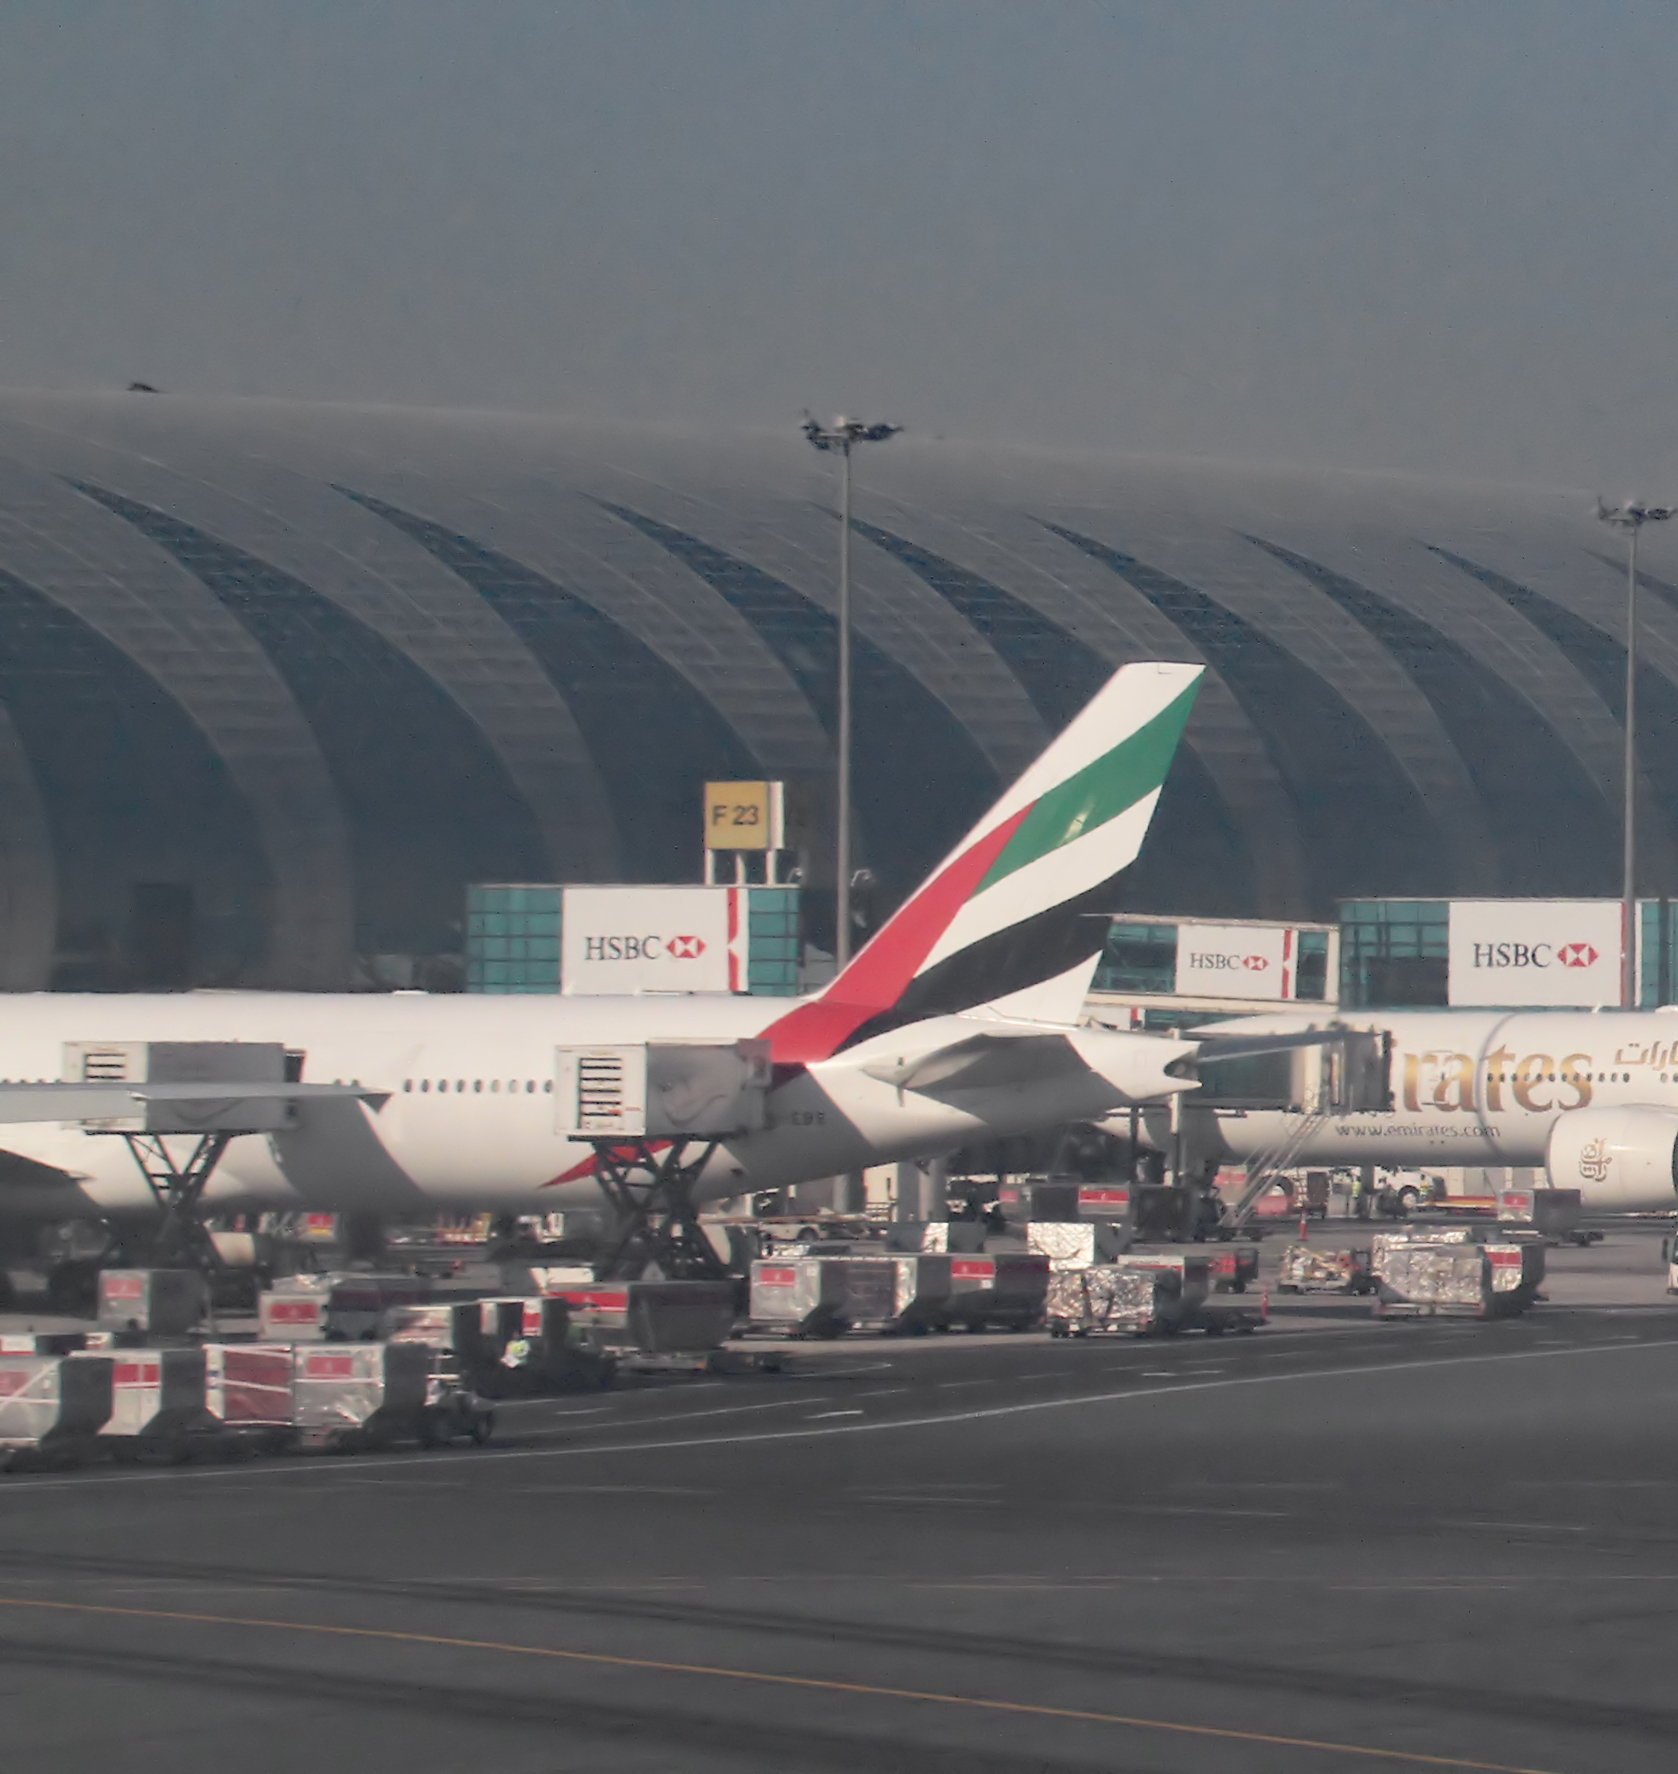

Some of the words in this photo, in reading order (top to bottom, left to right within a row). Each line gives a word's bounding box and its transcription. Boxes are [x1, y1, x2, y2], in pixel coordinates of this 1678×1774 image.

[712, 805, 727, 826] F
[731, 805, 758, 826] 23
[584, 935, 661, 960] HSBC
[1473, 943, 1552, 968] HSBC
[1190, 952, 1240, 970] HSBC
[1400, 1044, 1593, 1113] rates
[1334, 1122, 1501, 1138] www.emirates.com
